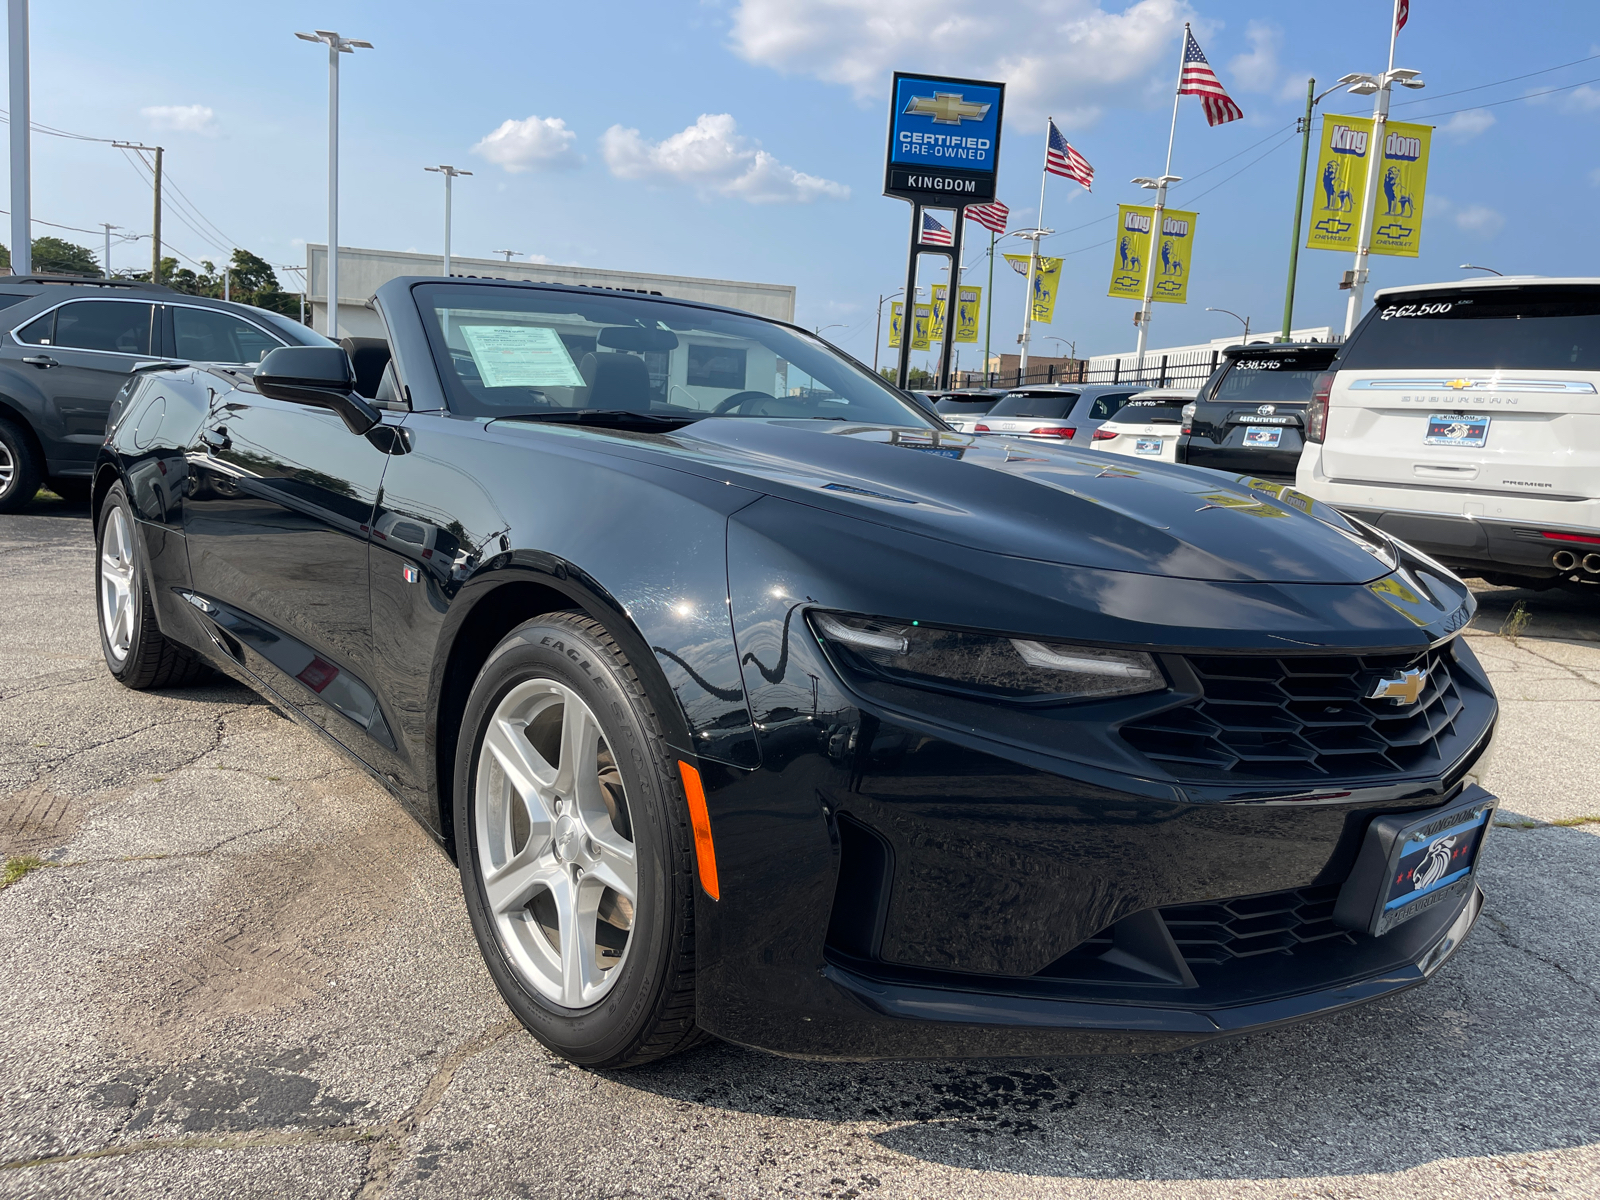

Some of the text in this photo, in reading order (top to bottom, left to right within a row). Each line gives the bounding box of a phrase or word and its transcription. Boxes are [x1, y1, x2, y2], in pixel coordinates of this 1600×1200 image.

[899, 131, 990, 149] CERTIFIED
[1330, 125, 1421, 159] King dom
[902, 143, 985, 161] PRE-OWNED
[908, 175, 976, 192] KINGDOM
[1124, 211, 1189, 236] King dom
[1314, 233, 1352, 243] CHEVROLET
[1376, 239, 1413, 247] CHEVROLET
[1381, 303, 1452, 321] $62,500
[1401, 395, 1519, 405] SUBURBAN
[1239, 415, 1287, 424] 4RUNNER
[1502, 479, 1553, 488] PREMIER
[539, 636, 609, 690] EAGLE
[1424, 806, 1477, 837] KINGDOM
[1396, 889, 1449, 922] CHEVROLET
